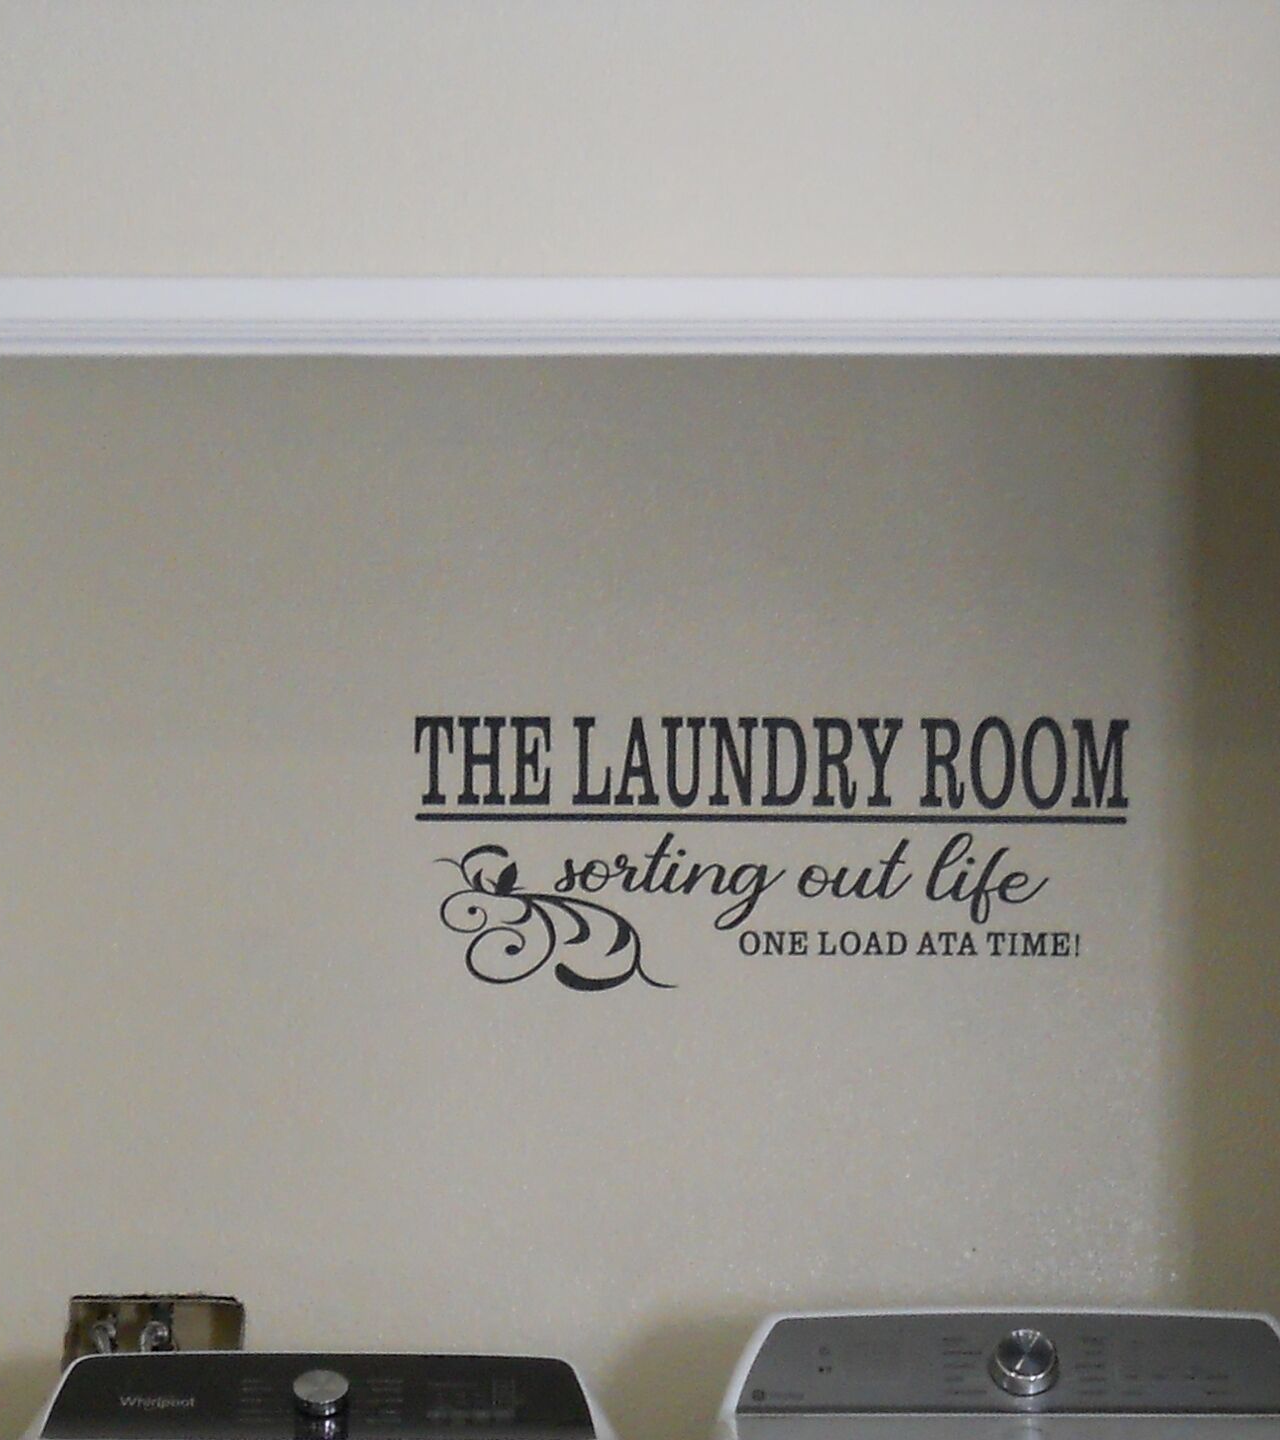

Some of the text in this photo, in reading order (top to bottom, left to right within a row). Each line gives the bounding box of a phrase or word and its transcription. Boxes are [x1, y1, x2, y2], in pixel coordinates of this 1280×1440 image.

[415, 716, 1130, 810] THE LAUNDRY ROOM
[555, 832, 1049, 930] sorting out life
[739, 931, 808, 956] ONE
[818, 931, 908, 956] LOAD
[987, 932, 1080, 957] TIME!
